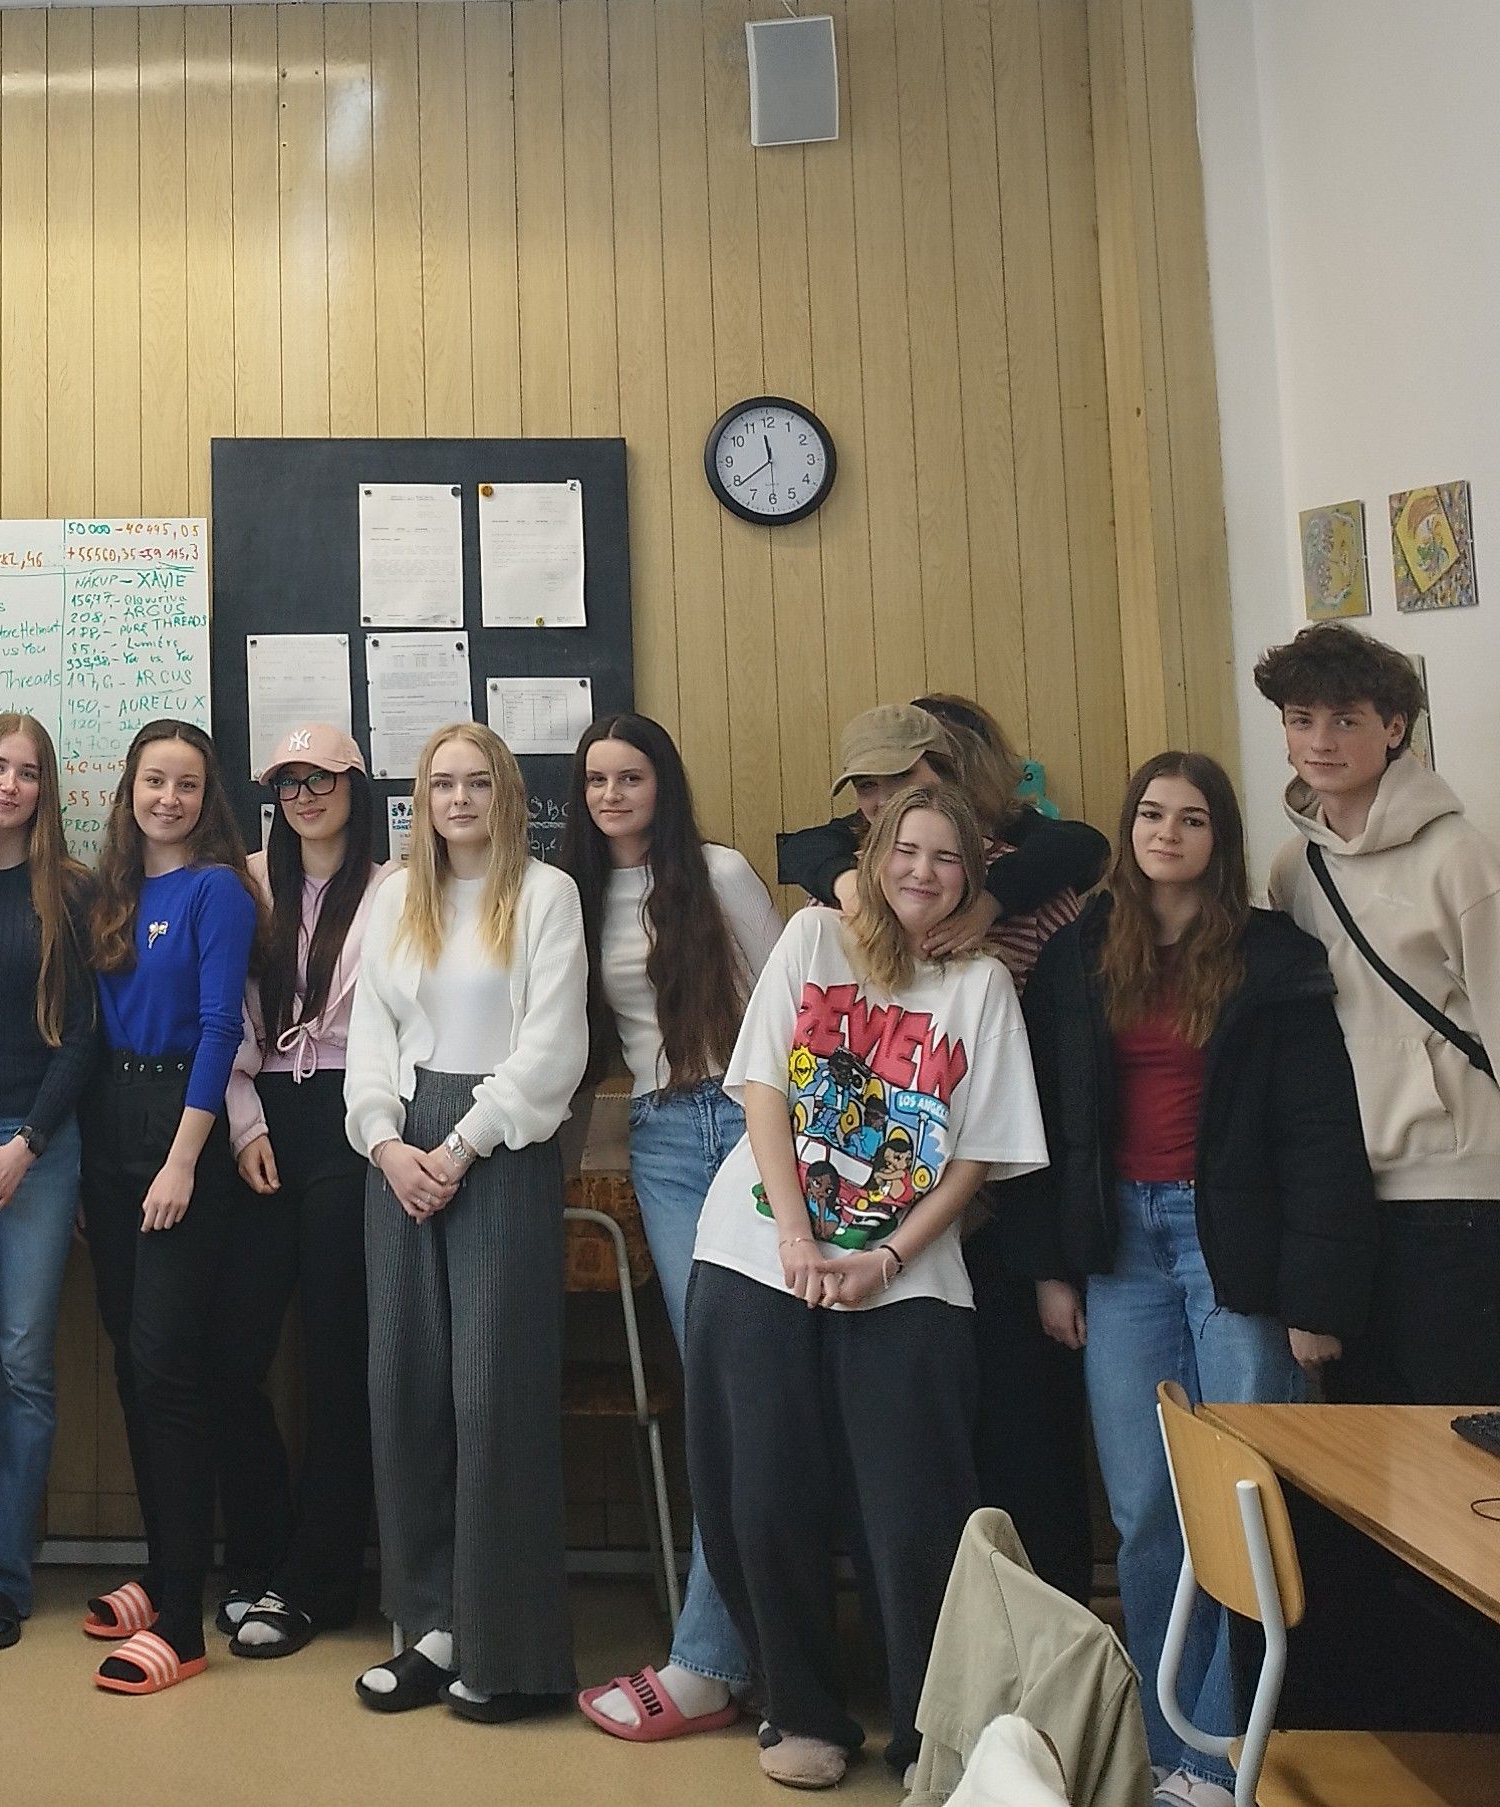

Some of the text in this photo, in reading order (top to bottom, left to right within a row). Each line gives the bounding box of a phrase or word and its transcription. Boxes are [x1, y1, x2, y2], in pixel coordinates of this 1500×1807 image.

[744, 422, 756, 434] 11
[761, 416, 775, 429] 12
[785, 421, 791, 433] 1
[731, 435, 745, 448] 10
[798, 434, 808, 446] 2
[725, 456, 734, 468] 9
[806, 453, 815, 465] 3
[733, 474, 741, 487] 8
[802, 473, 810, 485] 4
[749, 488, 758, 501] 7
[768, 492, 777, 505] 6
[787, 487, 796, 500] 5
[151, 615, 208, 631] THREADS
[136, 669, 193, 688] ARCUS
[118, 695, 207, 717] AURELUX
[288, 729, 312, 752] NY
[898, 1094, 918, 1108] LOS
[629, 1672, 665, 1717] UMA
